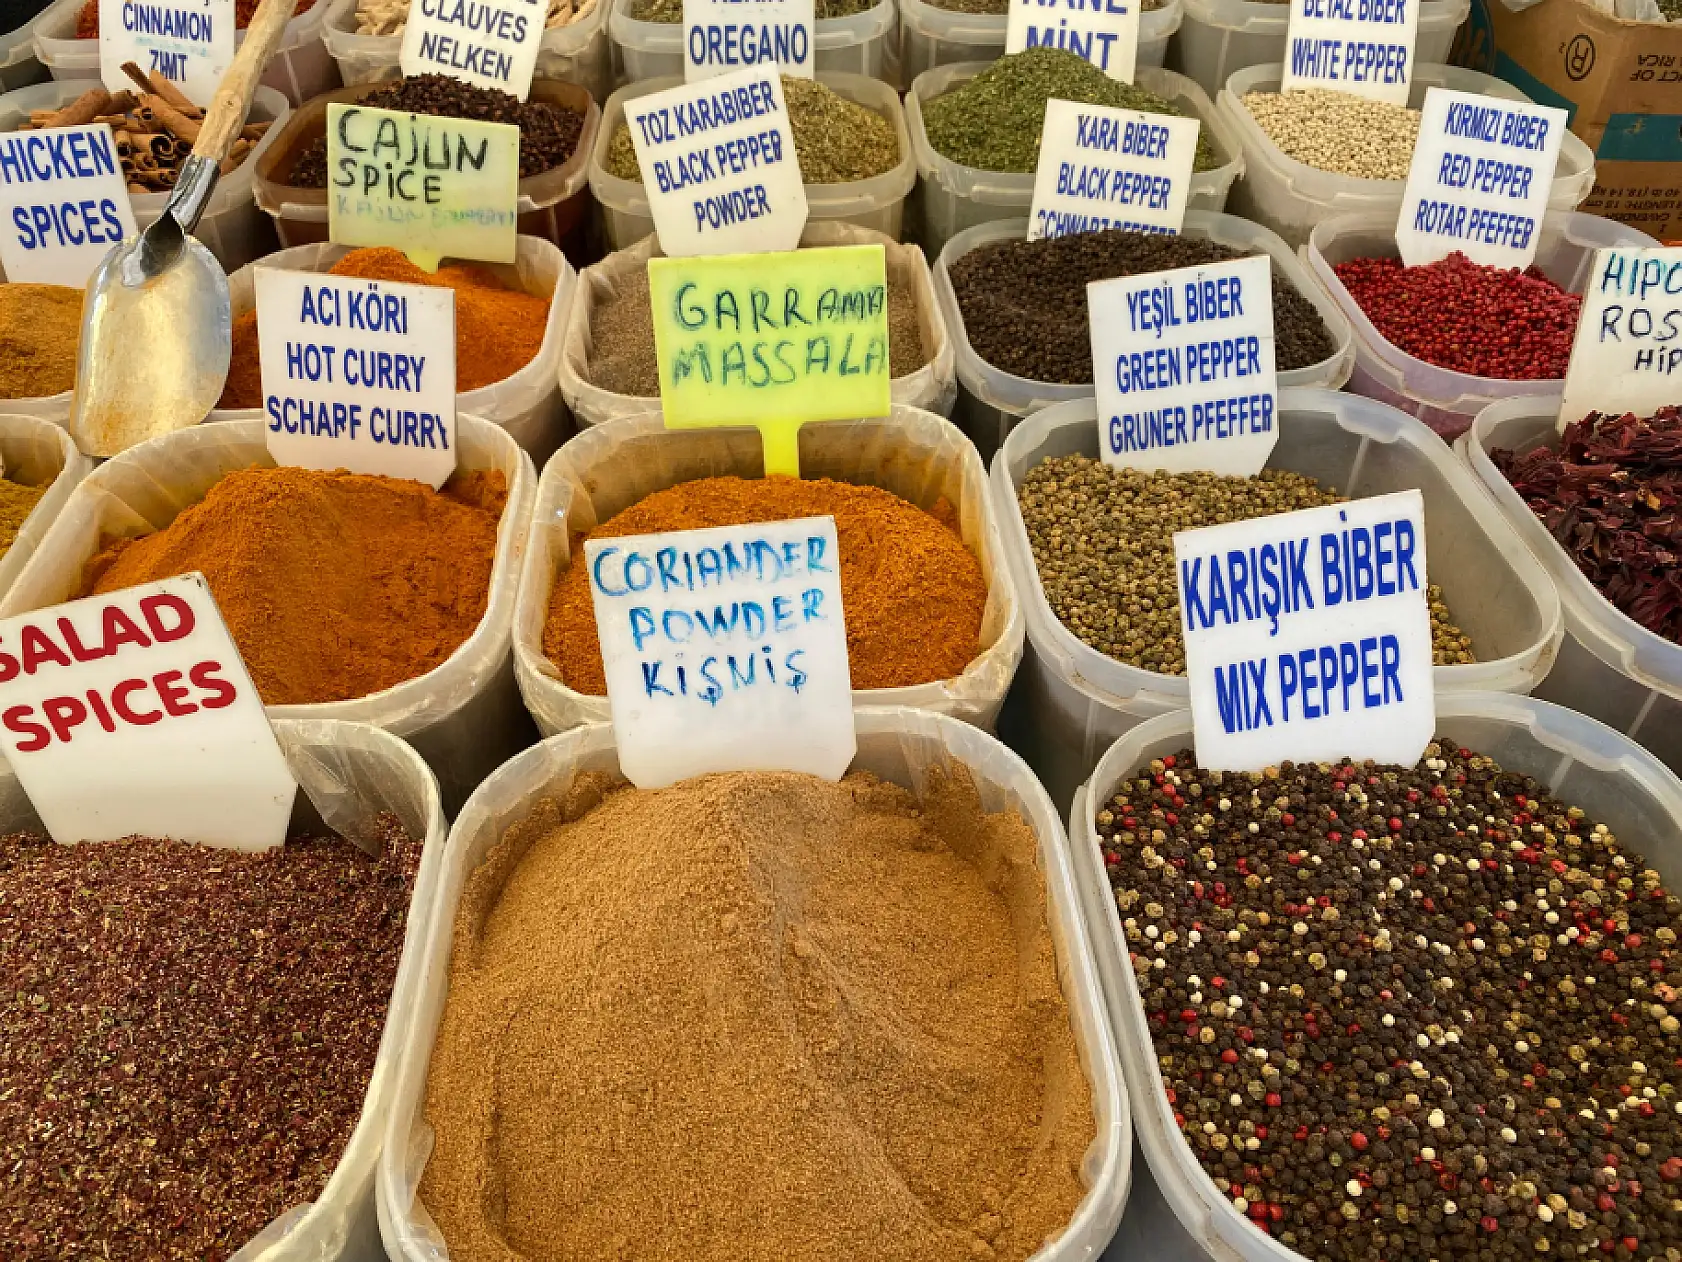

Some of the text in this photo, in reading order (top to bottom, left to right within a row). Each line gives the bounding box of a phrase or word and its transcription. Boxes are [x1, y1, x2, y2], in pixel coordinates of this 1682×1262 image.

[123, 3, 212, 42] CINNAMON
[421, 0, 528, 42] CLAUVES
[690, 23, 808, 65] OREGANO
[149, 49, 188, 82] ZIMT
[418, 31, 512, 81] NELKEN
[1292, 38, 1407, 83] WHITE PEPPER
[636, 80, 777, 147] TOZ KARABIBER
[1076, 114, 1119, 153] KARA
[1444, 102, 1502, 142] KIRMIZI
[0, 130, 115, 184] HICKEN
[653, 129, 783, 193] BLACK PEPPER
[1437, 152, 1534, 199] RED PEPPER
[694, 184, 772, 232] POWDER
[1057, 162, 1172, 211] BLACK PEPPER
[12, 198, 124, 250] SPICES
[1413, 198, 1536, 249] ROTAR PFEFFER
[301, 282, 408, 335] ACI KÖRI
[286, 341, 426, 393] HOT CURRY
[672, 333, 886, 388] MASSALA
[1117, 335, 1261, 394] GREEN PEPPER
[266, 395, 362, 440] SCHARF
[1109, 393, 1274, 455] GRUNER PFEFFER
[593, 536, 832, 597] CORIANDER
[1182, 536, 1315, 637] KARIŞIK
[629, 588, 828, 651] POWDER
[2, 660, 237, 752] SPICES
[1214, 634, 1404, 734] MIX PEPPER
